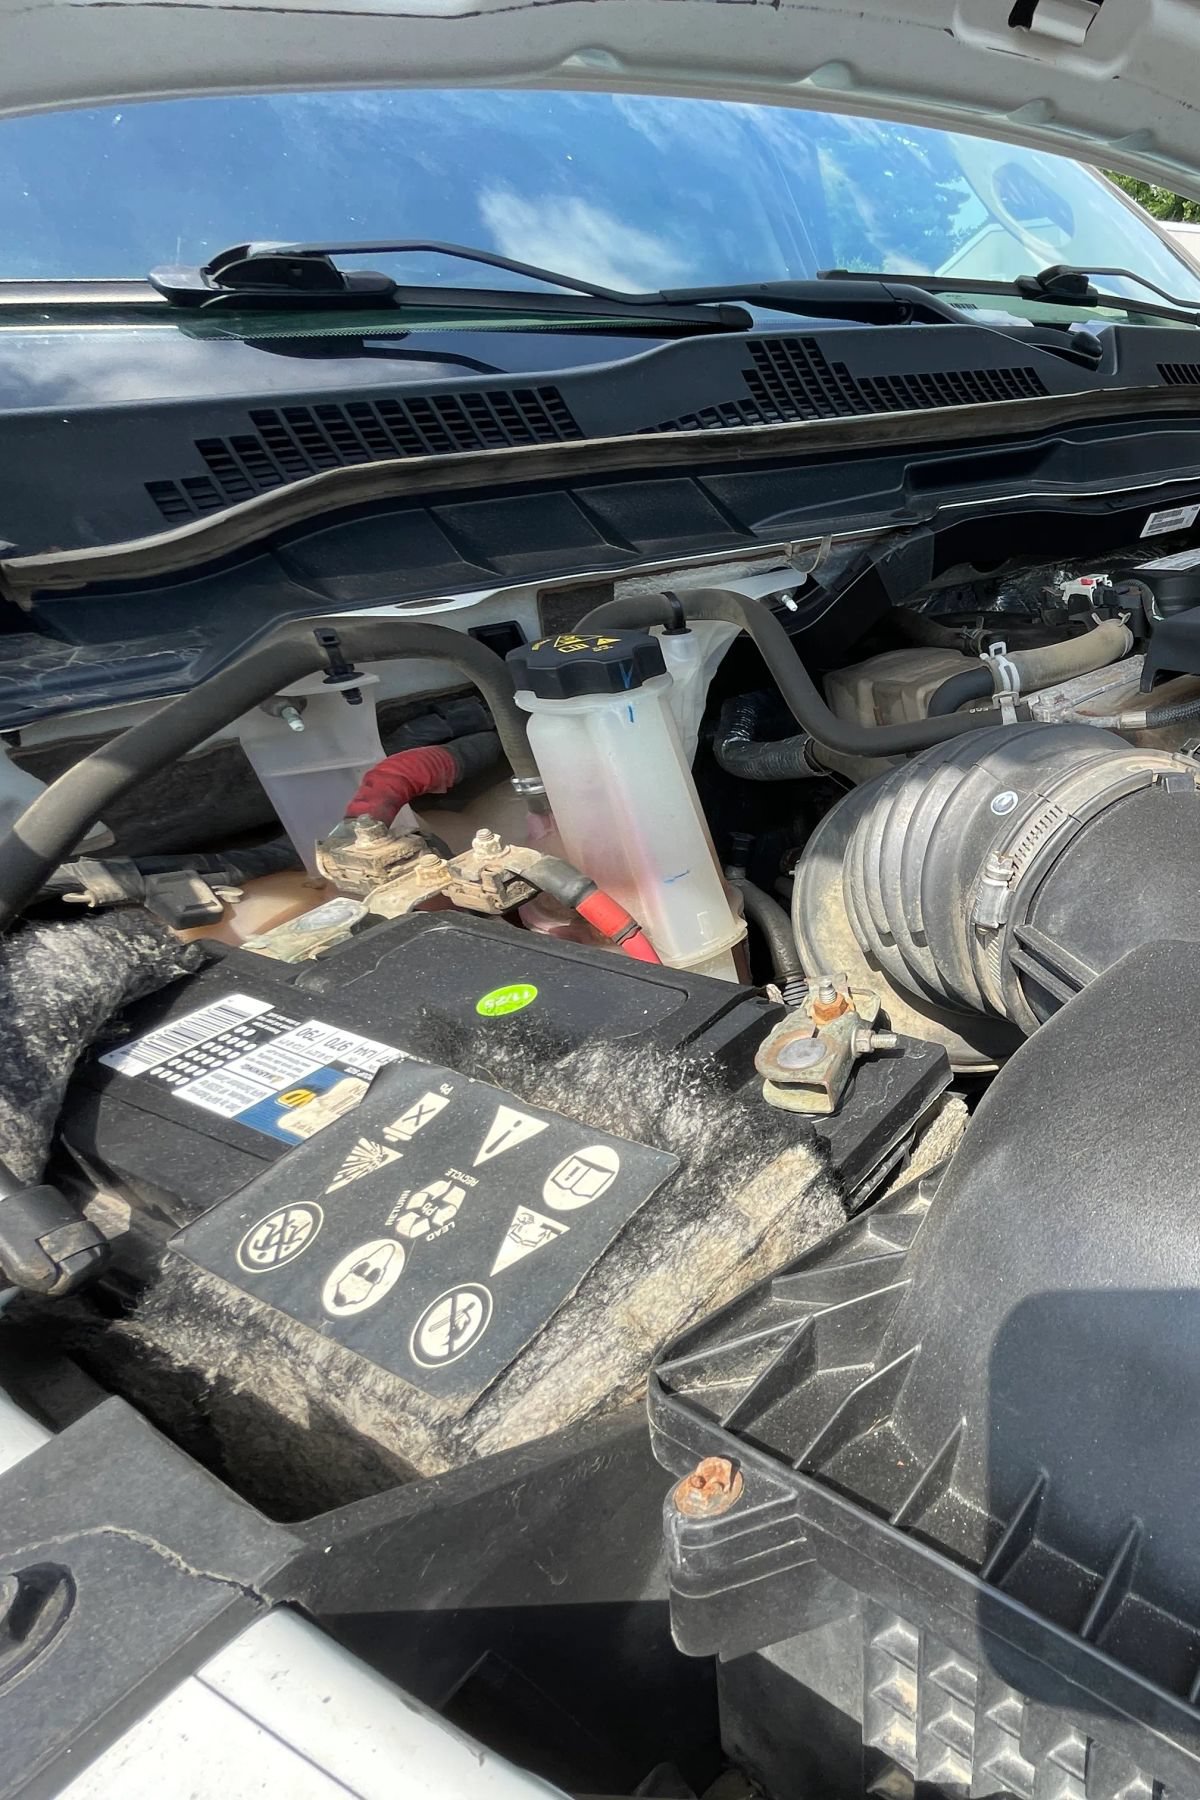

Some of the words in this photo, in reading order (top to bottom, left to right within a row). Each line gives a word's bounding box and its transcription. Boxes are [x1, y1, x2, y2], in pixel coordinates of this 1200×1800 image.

[295, 1027, 326, 1042] 790
[323, 1037, 354, 1052] 970
[439, 1083, 454, 1095] Pb
[444, 1167, 480, 1188] RECYCLE
[384, 1189, 412, 1226] RETURN
[421, 1202, 439, 1217] Pb
[425, 1221, 456, 1242] LEAD
